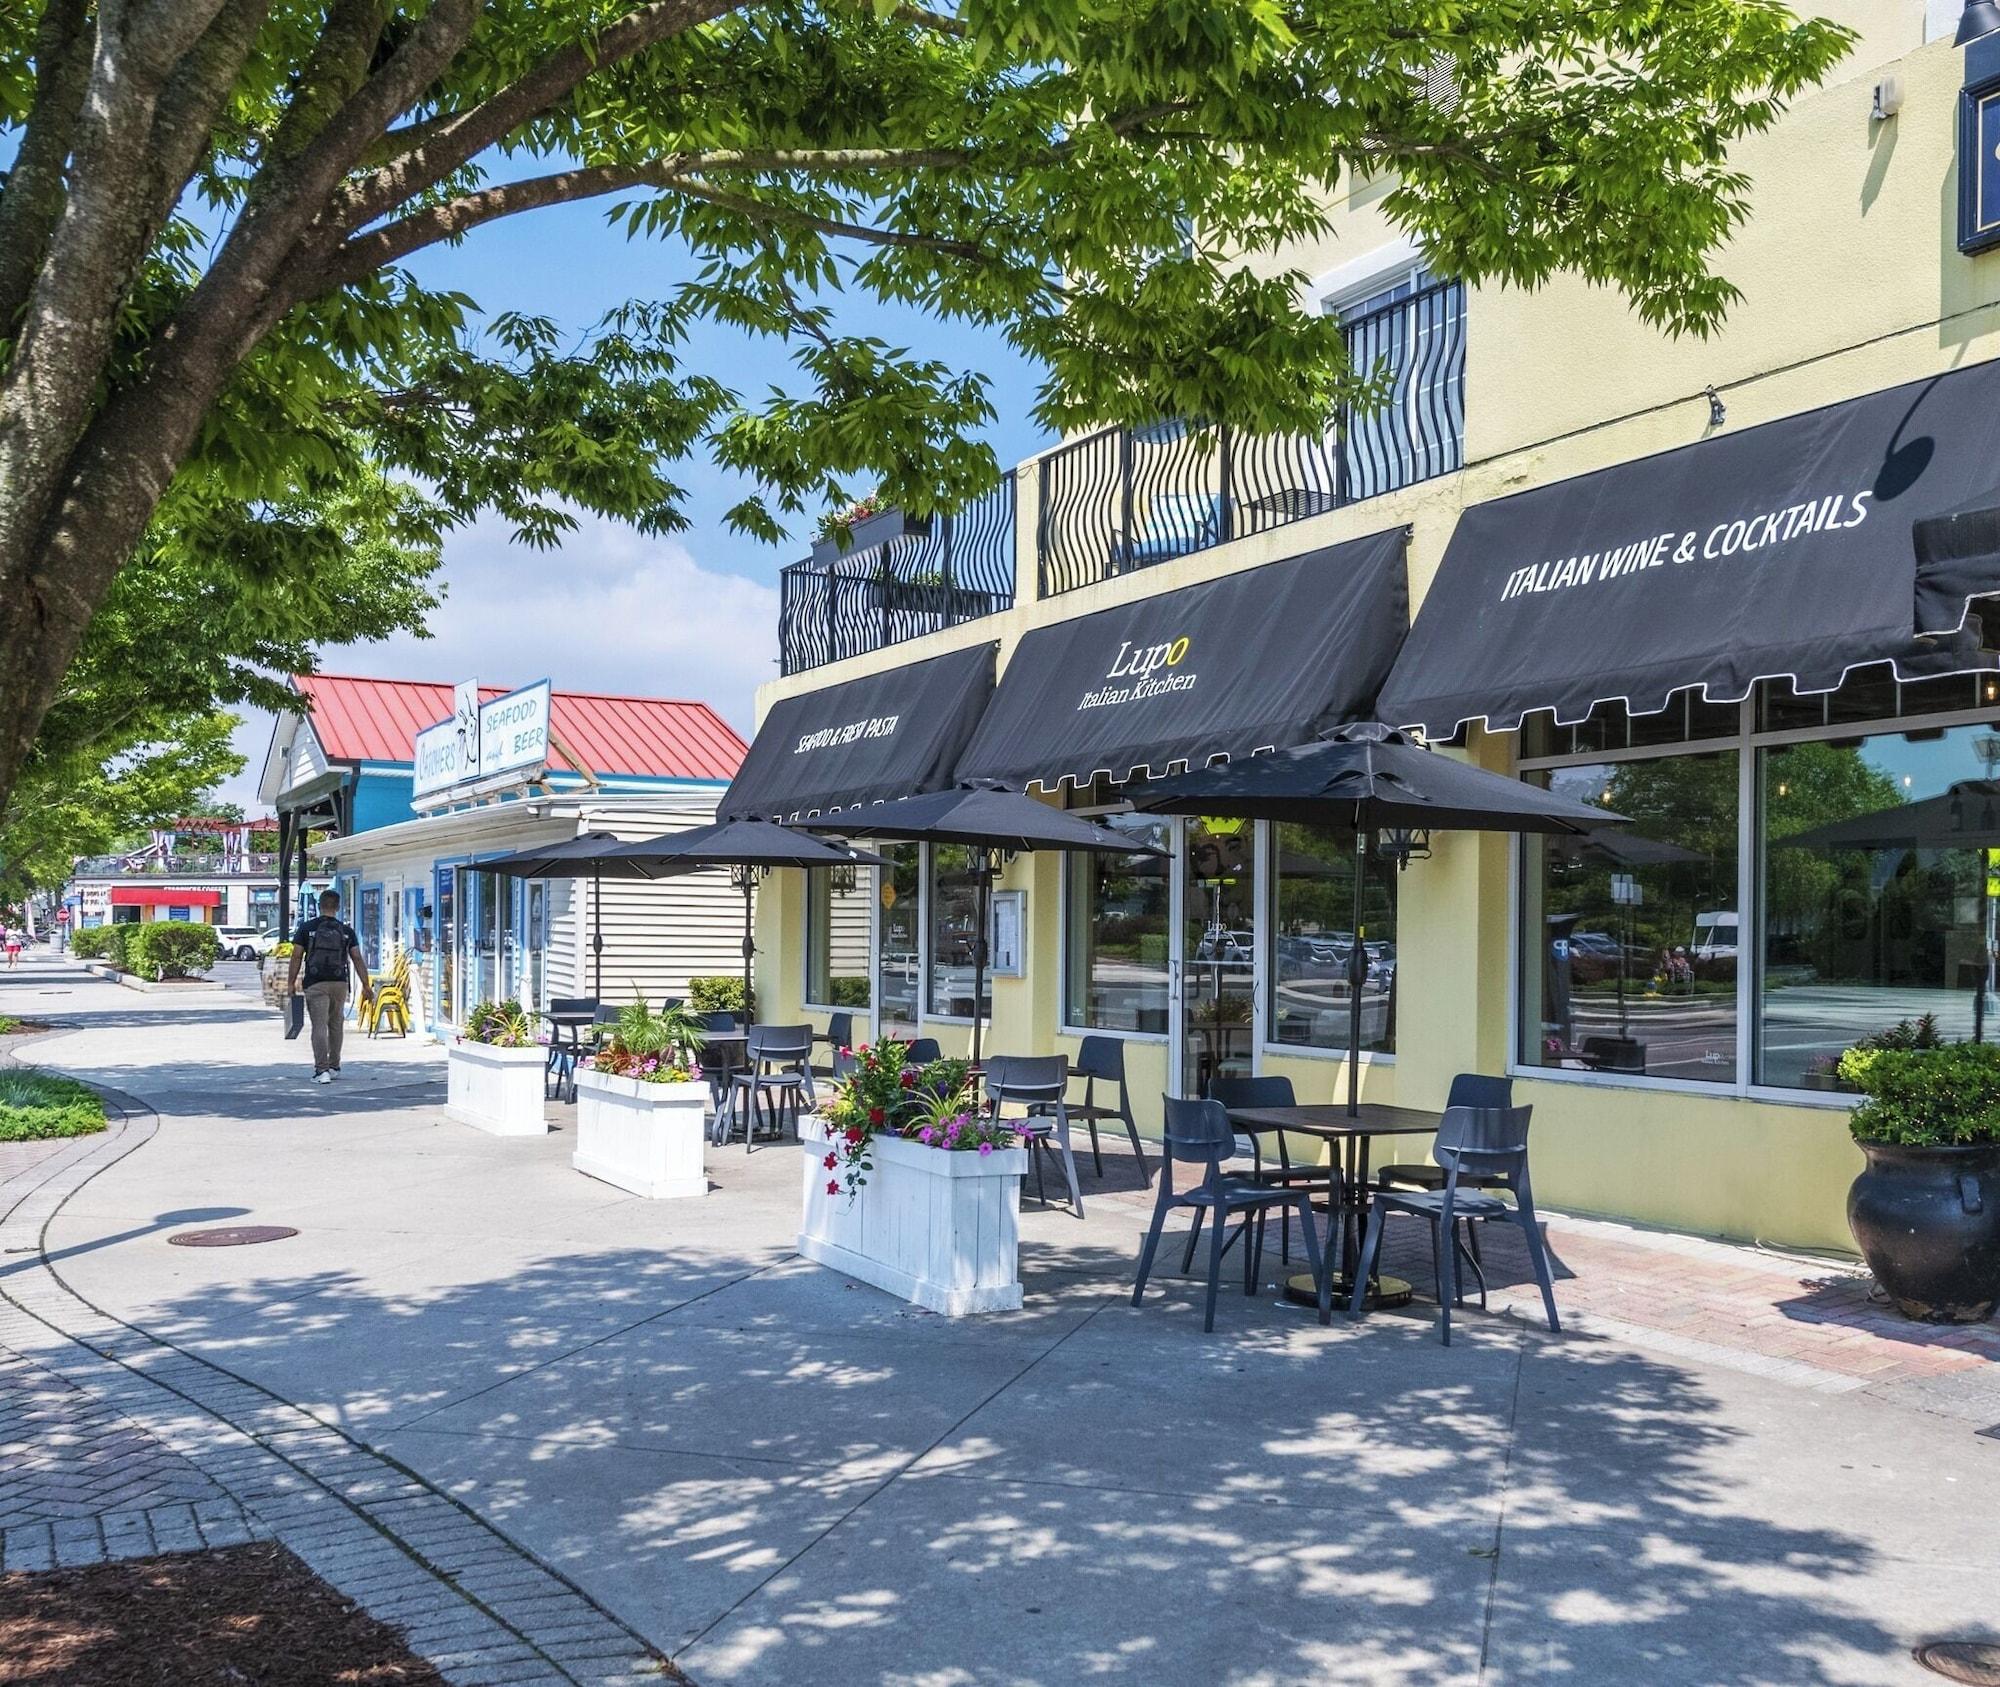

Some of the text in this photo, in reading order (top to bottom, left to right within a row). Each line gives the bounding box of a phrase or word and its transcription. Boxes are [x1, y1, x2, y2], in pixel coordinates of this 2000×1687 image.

[1500, 490, 1873, 602] ITALIAN WINE & COCKTAILS
[1106, 637, 1189, 680] Lupo
[1077, 672, 1197, 710] Italian Kitchen
[486, 699, 537, 734] SEAFOOD
[794, 715, 899, 754] SEAFOOD & FRESH PASTA
[513, 727, 545, 755] BEER
